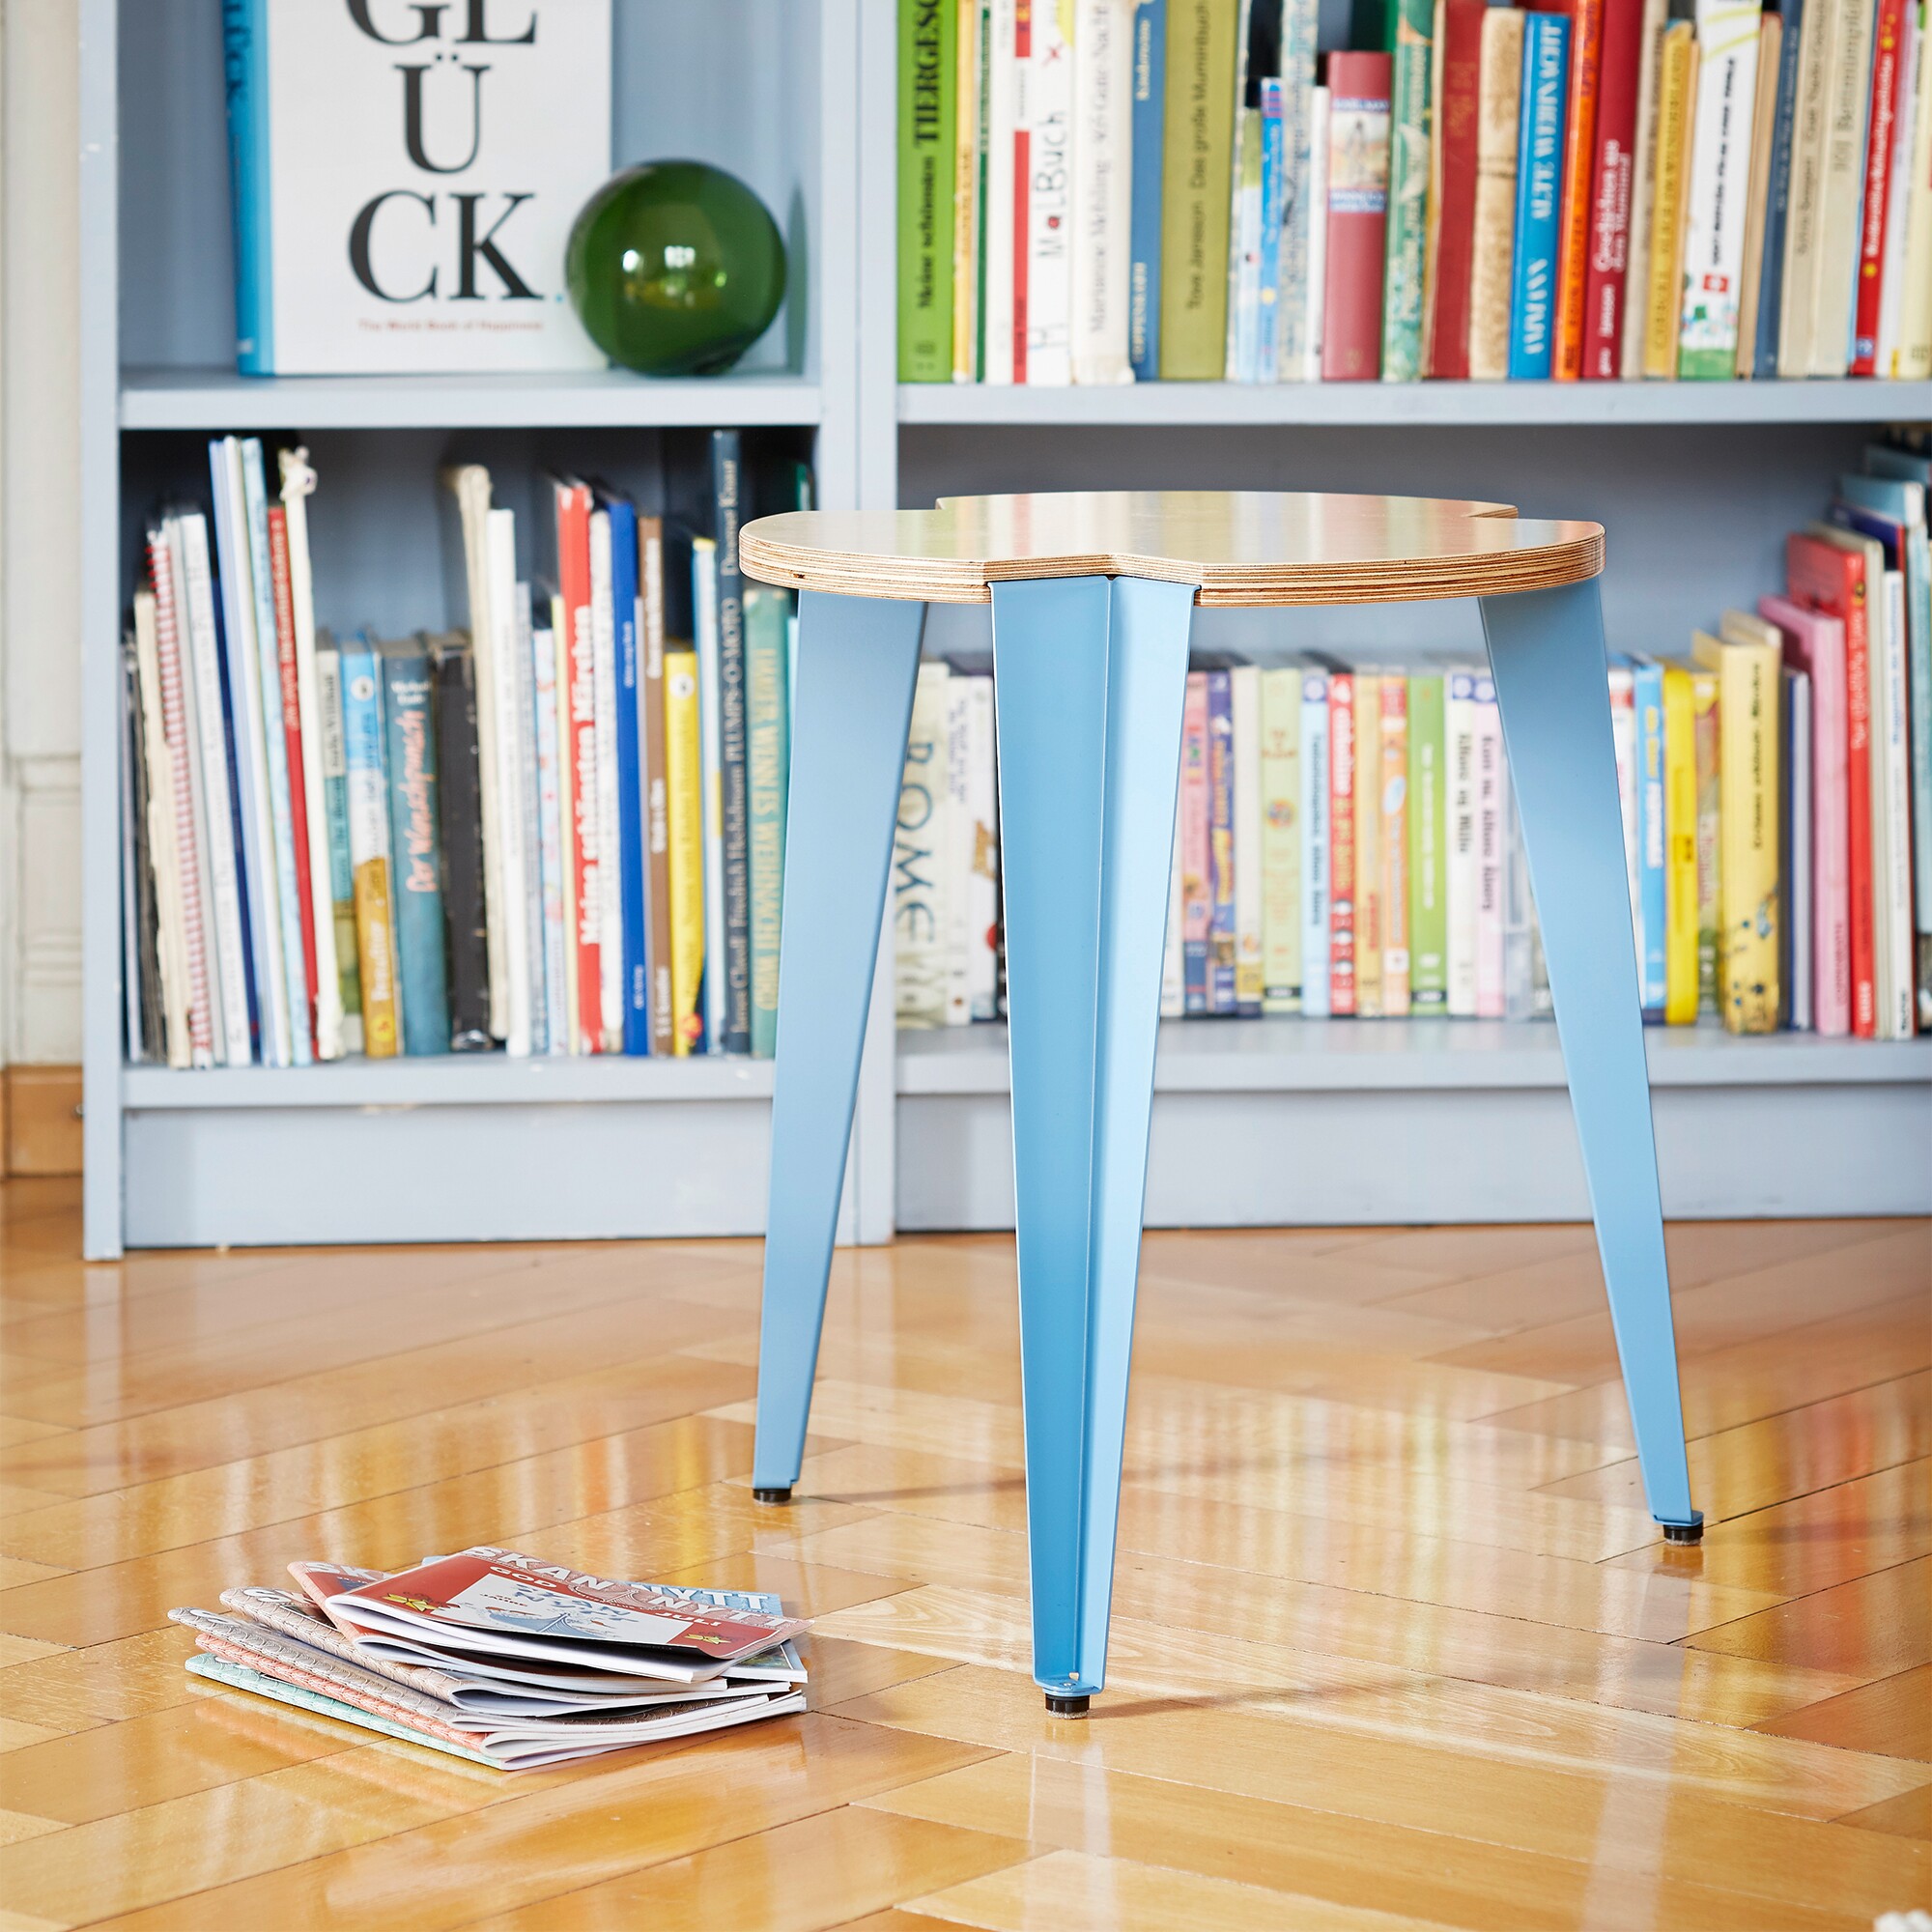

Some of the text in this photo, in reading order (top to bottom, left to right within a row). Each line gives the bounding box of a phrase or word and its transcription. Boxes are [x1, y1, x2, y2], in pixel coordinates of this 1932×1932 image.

[392, 52, 492, 174] Ü
[1531, 19, 1563, 157] WEIHNACHT
[1190, 105, 1209, 153] große
[915, 156, 936, 249] schönsten
[1189, 156, 1206, 188] Das
[1529, 161, 1554, 219] ALTE
[1188, 201, 1205, 270] Jansson
[916, 253, 937, 310] Meine
[1187, 274, 1204, 309] Tove
[571, 606, 603, 945] Meine schönsten Märchen
[753, 727, 779, 787] WENN
[394, 709, 437, 893] Der Wunschpunsch
[753, 789, 779, 815] ES
[724, 866, 745, 929] Friedrich
[753, 824, 779, 952] WEIHNACHT
[754, 956, 780, 1010] WIRD
[464, 1547, 798, 1628] SKAN NYTT
[490, 1565, 557, 1588] GOD
